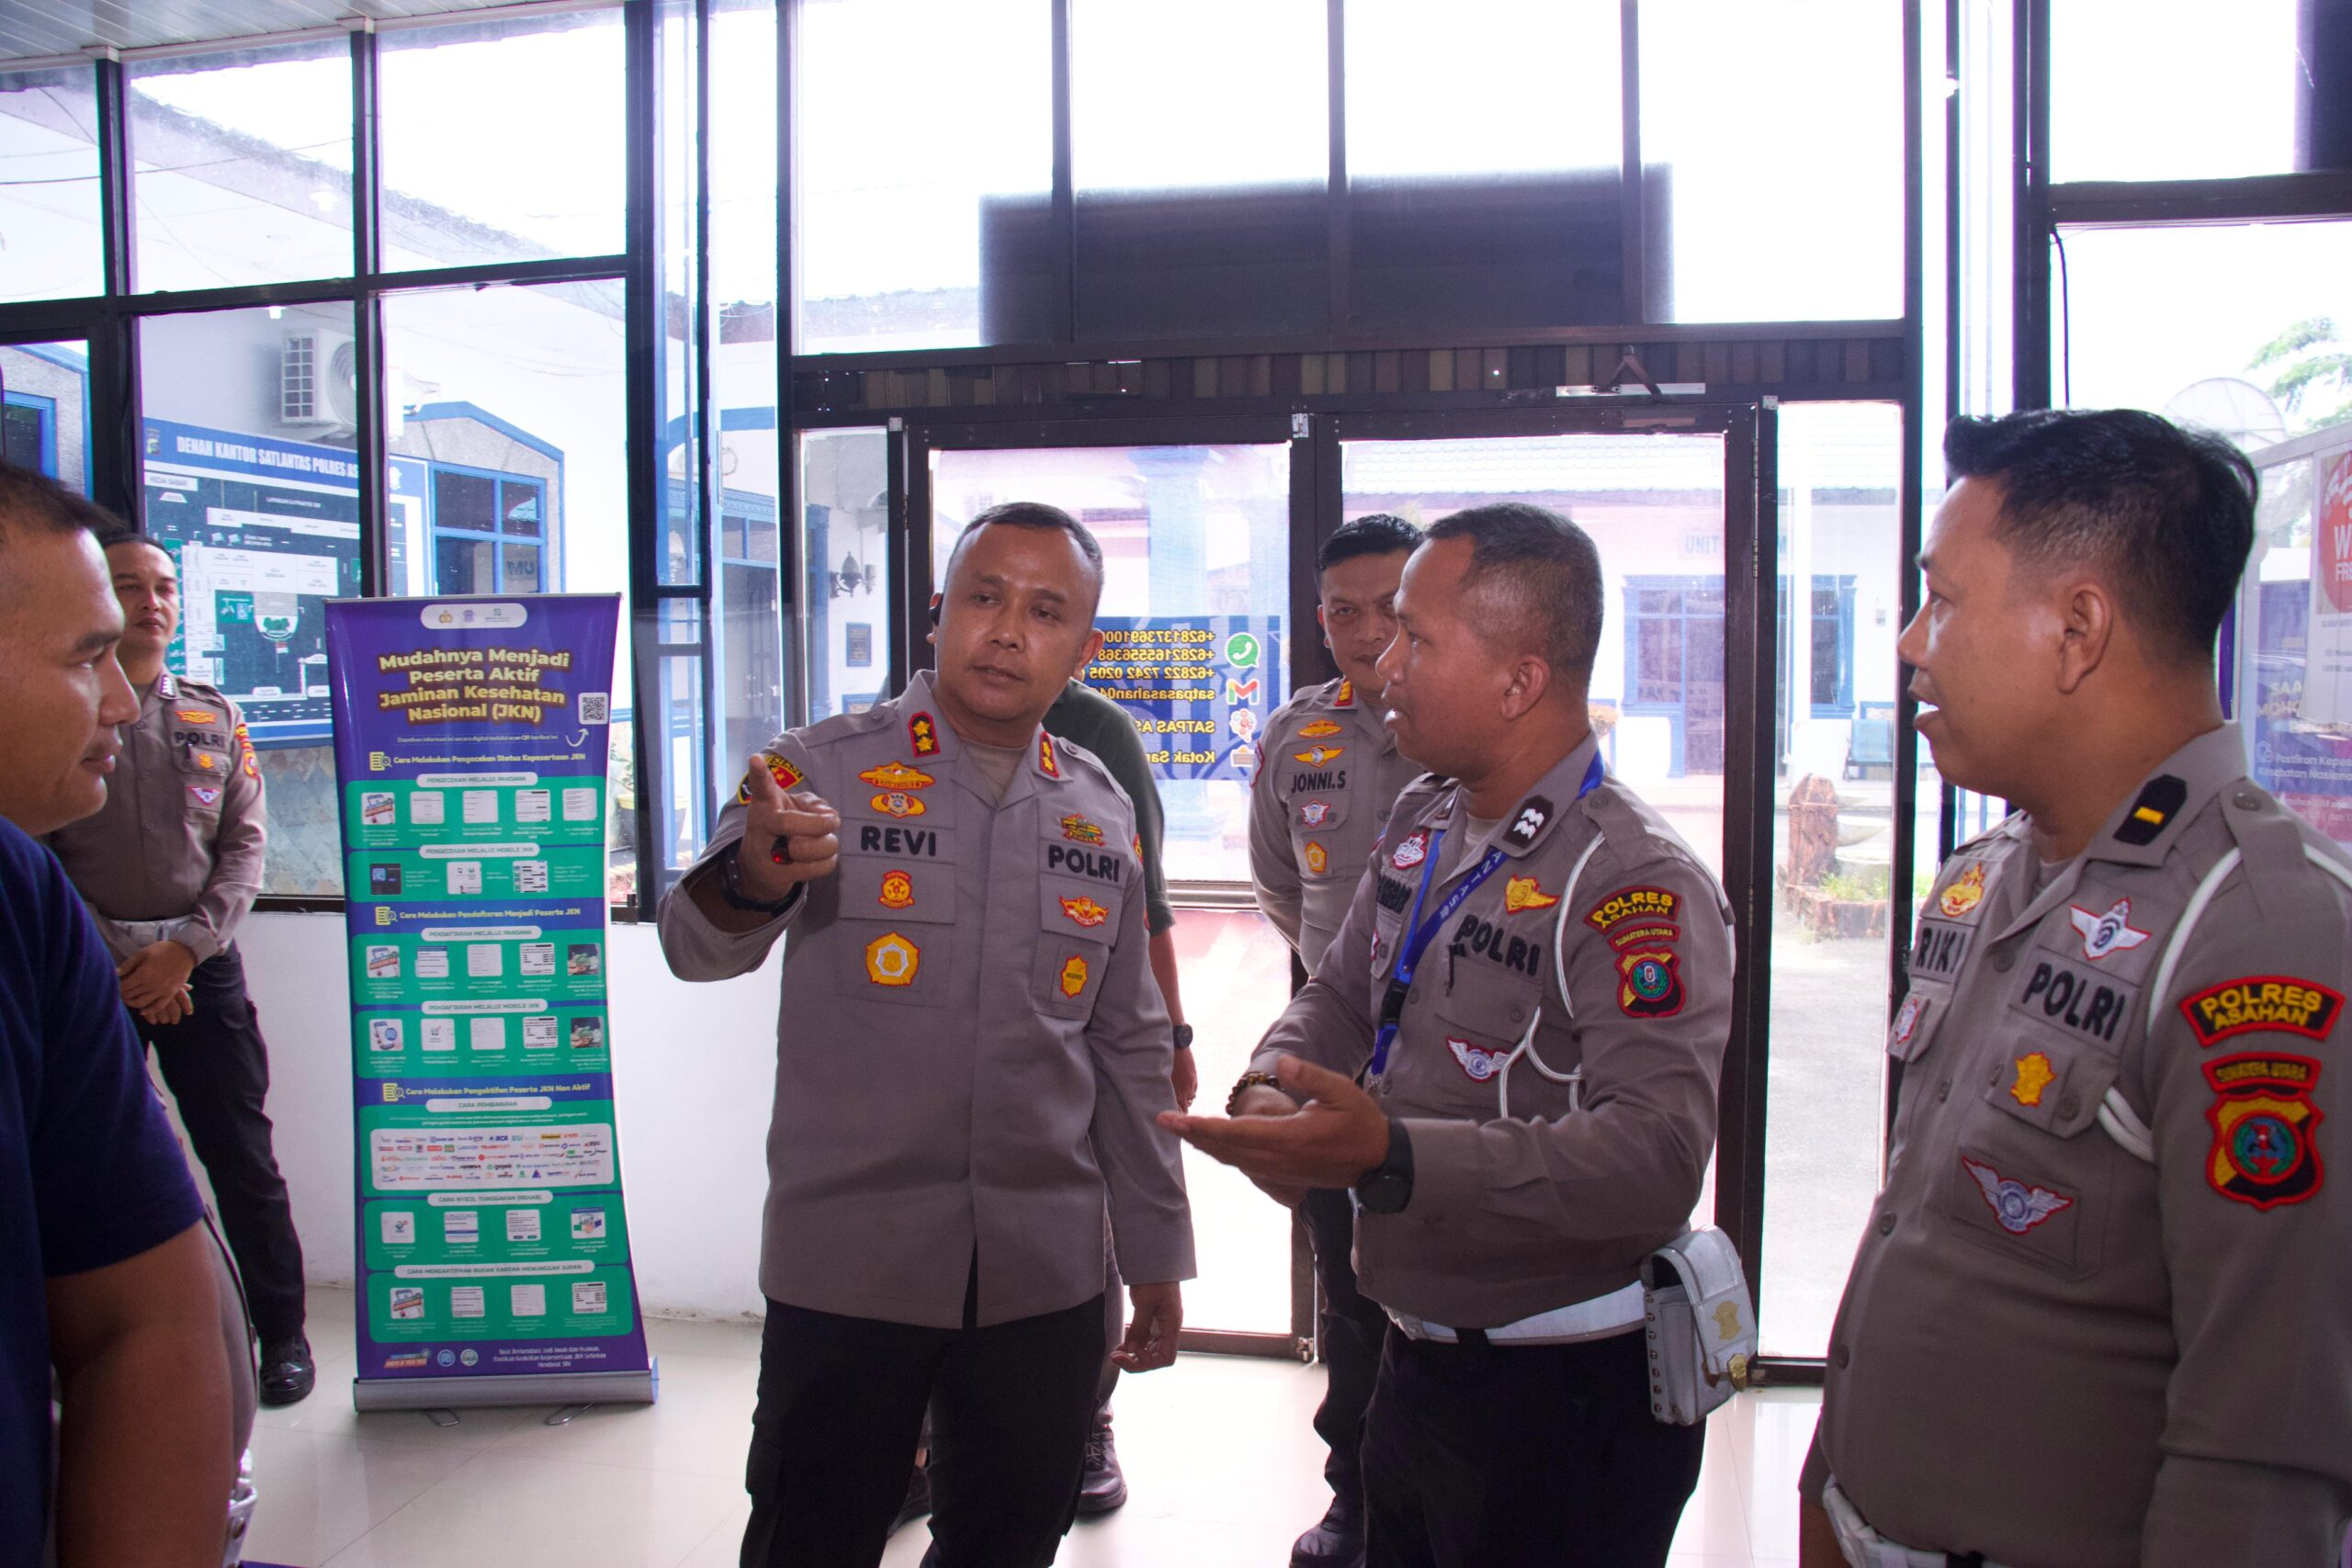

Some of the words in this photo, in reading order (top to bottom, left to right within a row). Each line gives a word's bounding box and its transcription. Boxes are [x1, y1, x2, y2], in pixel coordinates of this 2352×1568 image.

[176, 436, 213, 457] DENAH
[215, 442, 257, 463] KANTOR
[258, 448, 311, 472] SATLANTAS
[313, 457, 345, 476] POLRES
[379, 649, 483, 670] Mudahnya
[489, 649, 571, 668] Menjadi
[410, 669, 484, 684] Peserta
[490, 667, 540, 682] Aktif
[379, 687, 459, 708] Jaminan
[464, 685, 566, 705] Kesehatan
[408, 704, 487, 721] Nasional
[492, 704, 541, 723] (JKN)
[175, 731, 225, 748] POLRI
[412, 755, 450, 763] Melakukan
[571, 752, 586, 761] JKN
[1291, 770, 1346, 794] JONNI.S
[860, 826, 936, 856] REVI
[1048, 844, 1120, 883] POLRI
[535, 908, 563, 917] Peserta
[1591, 891, 1673, 924] POLRES
[1601, 905, 1668, 930] ASAHAN
[1453, 914, 1541, 976] POLRI
[1615, 929, 1650, 946] SUMATERA
[1651, 928, 1673, 936] UTARA
[1917, 927, 1966, 975] RIKI
[2022, 963, 2125, 1043] POLRI
[2199, 983, 2323, 1021] POLRES
[2214, 1004, 2311, 1031] ASAHAN
[571, 1083, 591, 1091] Aktif
